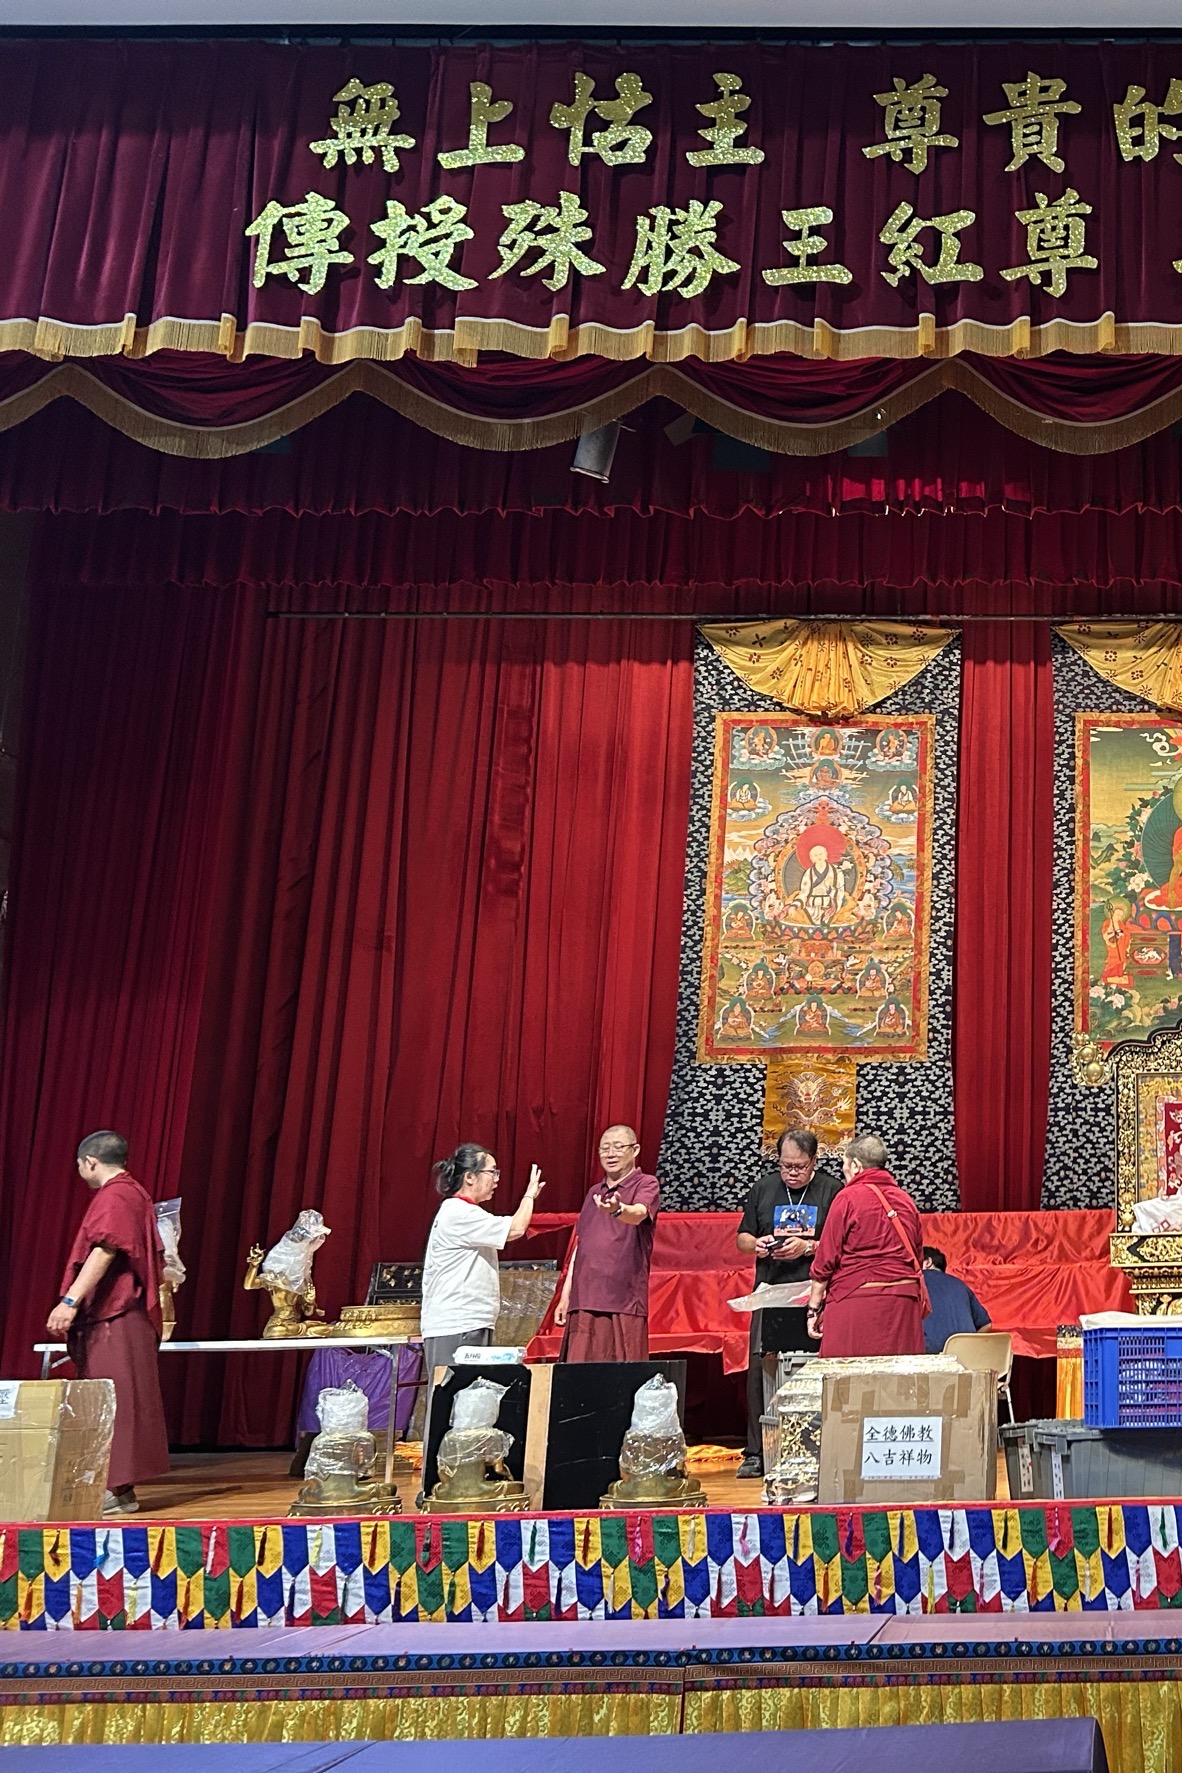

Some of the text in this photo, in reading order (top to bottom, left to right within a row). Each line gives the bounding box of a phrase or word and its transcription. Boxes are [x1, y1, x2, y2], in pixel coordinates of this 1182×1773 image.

[309, 72, 765, 173] 無上怙主
[245, 188, 1098, 299] 傳授殊勝王紅尊
[864, 1448, 932, 1466] 八吉祥物
[865, 1424, 933, 1441] 全德佛教
